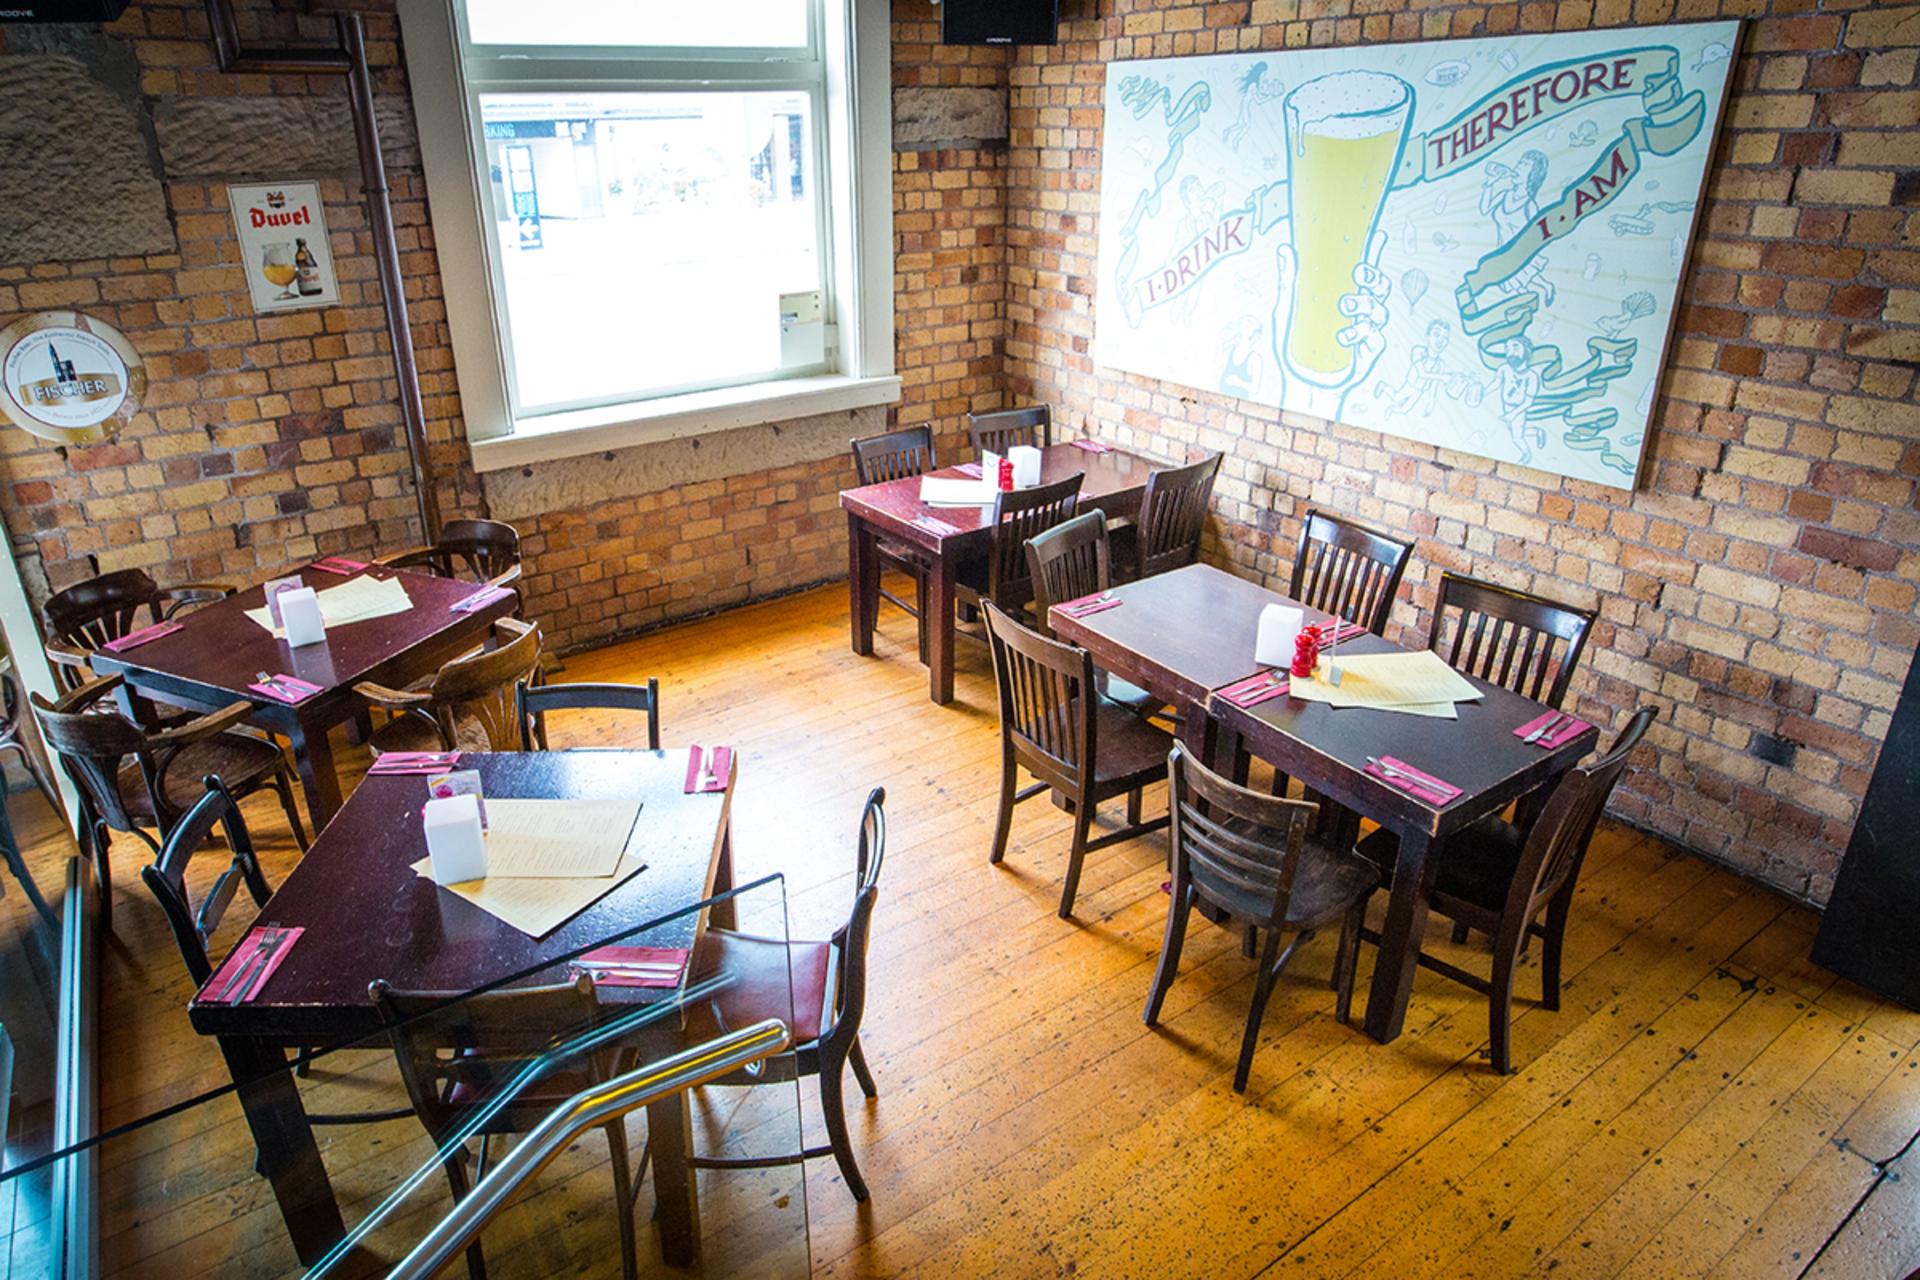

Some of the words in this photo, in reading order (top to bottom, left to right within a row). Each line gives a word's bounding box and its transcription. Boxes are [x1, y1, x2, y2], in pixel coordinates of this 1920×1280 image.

[1428, 59, 1637, 169] THEREFORE
[249, 205, 311, 229] Duvel
[1574, 147, 1629, 219] AM
[1164, 215, 1246, 295] DRINK
[33, 379, 108, 401] FISCHER
